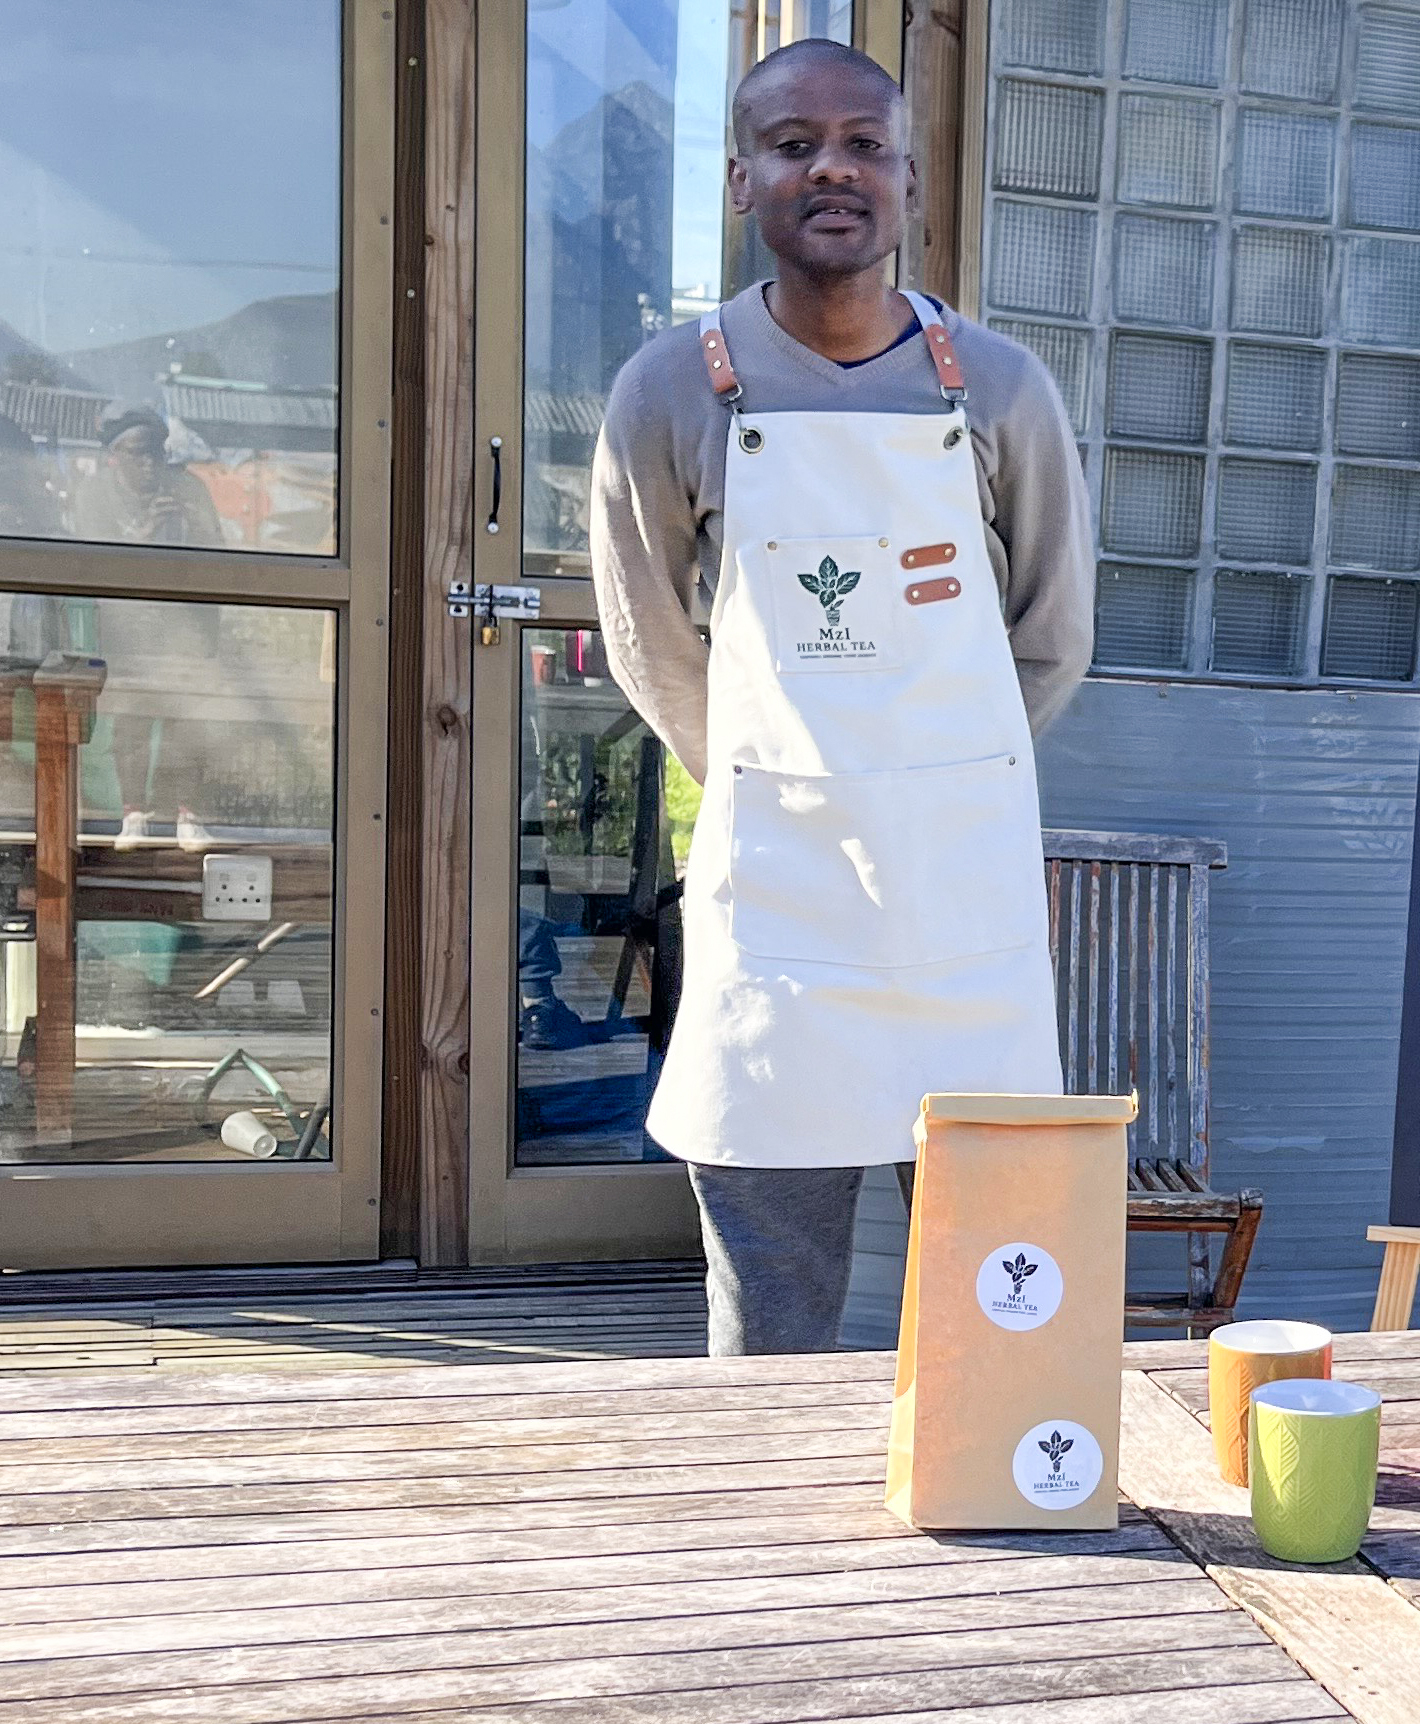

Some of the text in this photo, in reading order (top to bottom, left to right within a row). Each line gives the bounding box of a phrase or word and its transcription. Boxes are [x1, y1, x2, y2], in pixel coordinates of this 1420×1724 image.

[796, 640, 876, 653] HERBAL TEA
[992, 1301, 1021, 1310] HERBAL
[1024, 1304, 1038, 1312] TEA
